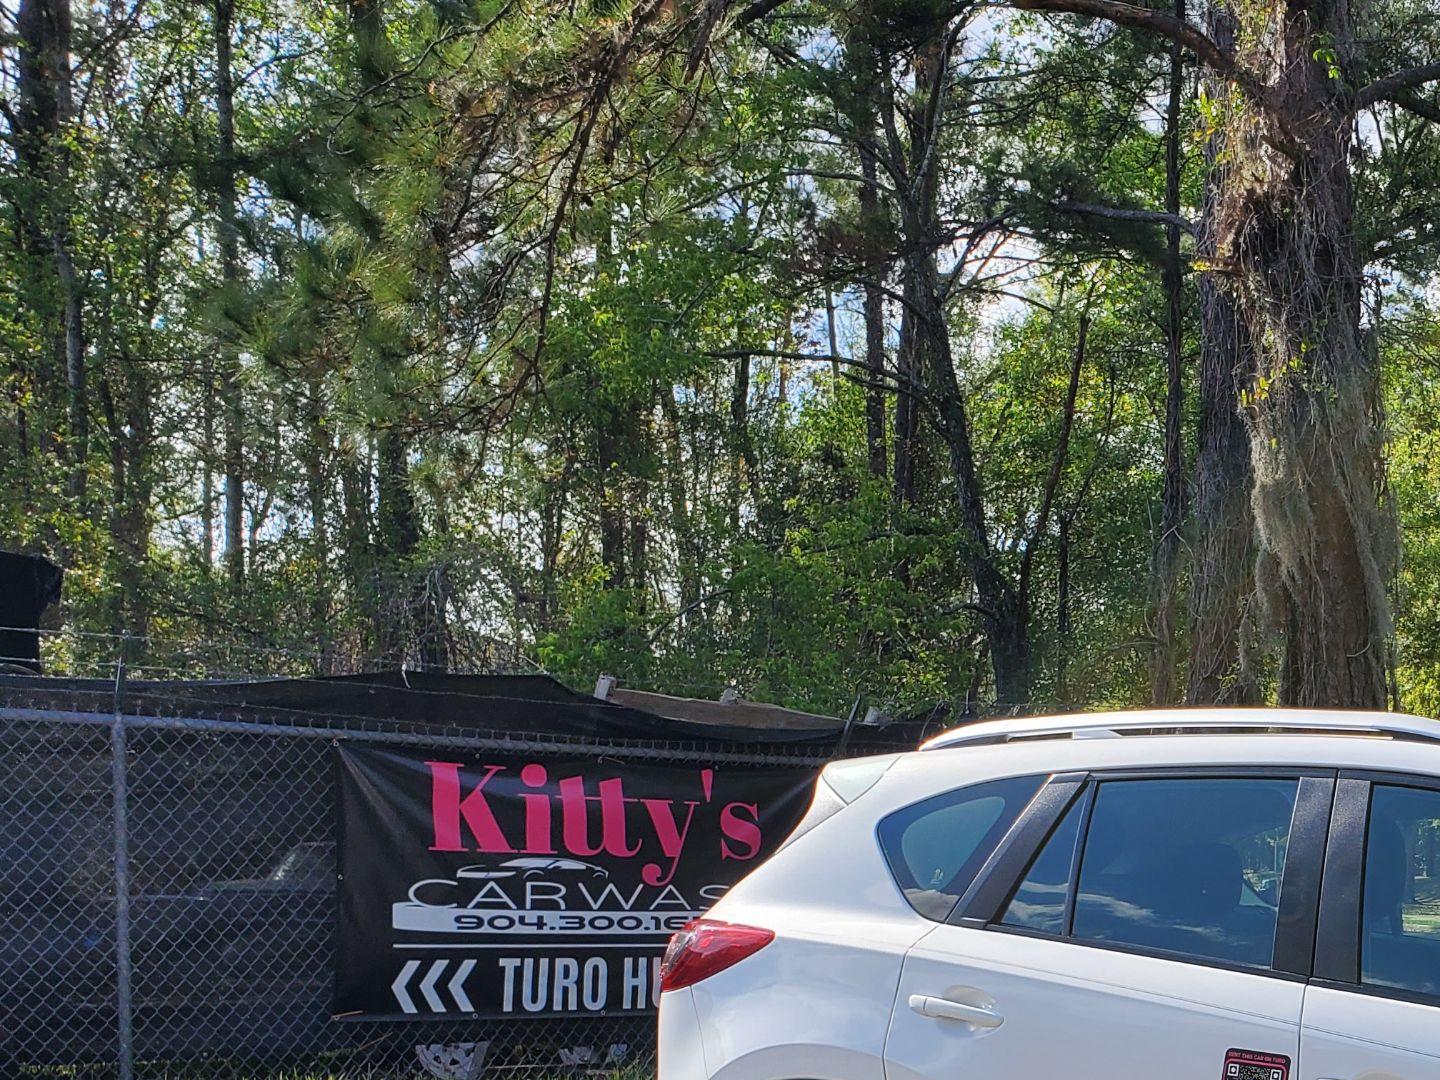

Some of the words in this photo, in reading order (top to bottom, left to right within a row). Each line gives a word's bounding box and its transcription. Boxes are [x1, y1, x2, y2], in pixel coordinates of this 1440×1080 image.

[424, 761, 762, 887] Kitty's
[453, 915, 701, 931] 904.300.16
[498, 956, 608, 1012] TURO
